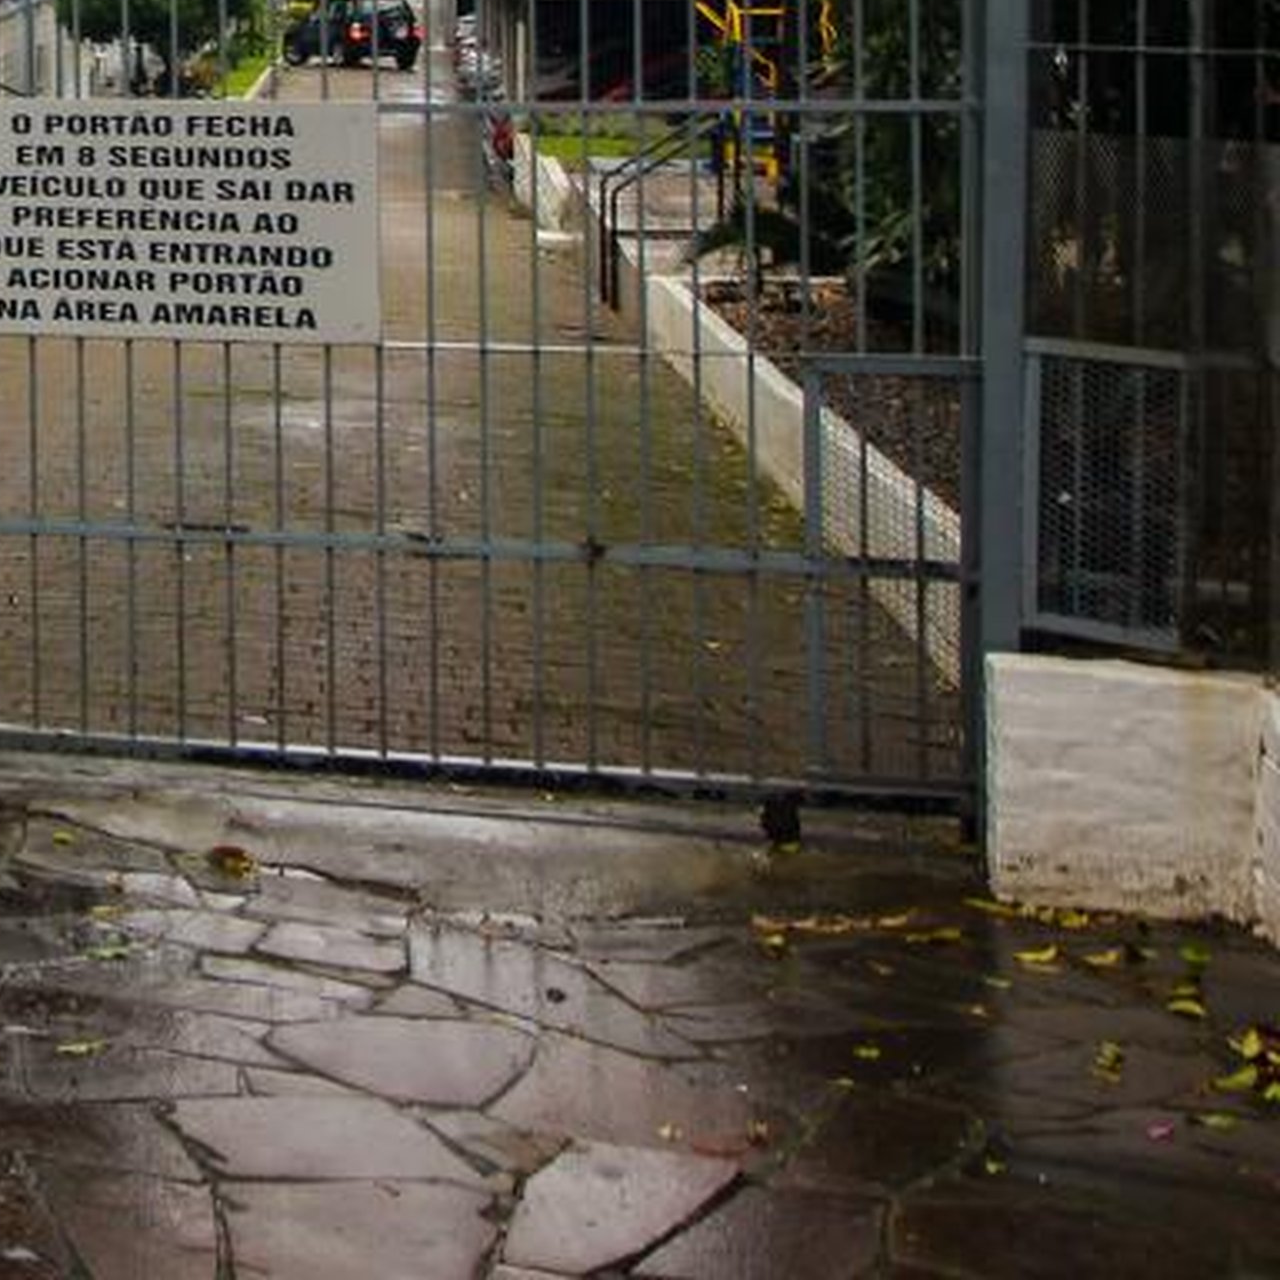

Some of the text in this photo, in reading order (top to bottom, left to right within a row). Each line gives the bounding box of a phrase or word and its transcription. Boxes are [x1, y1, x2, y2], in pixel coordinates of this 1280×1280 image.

[11, 114, 295, 138] O PORTÃO FECHA
[16, 145, 292, 171] EM 8 SEGUNDOS
[138, 178, 206, 202] QUE
[216, 179, 273, 202] SAI
[285, 181, 356, 205] DAR
[12, 206, 299, 235] PREFERÊNCIA AO
[56, 237, 137, 262] ESTÁ
[148, 242, 334, 269] ENTRANDO
[6, 268, 304, 298] ACIONAR PORTÃO
[52, 297, 140, 324] ÁREA
[150, 303, 318, 330] AMARELA
